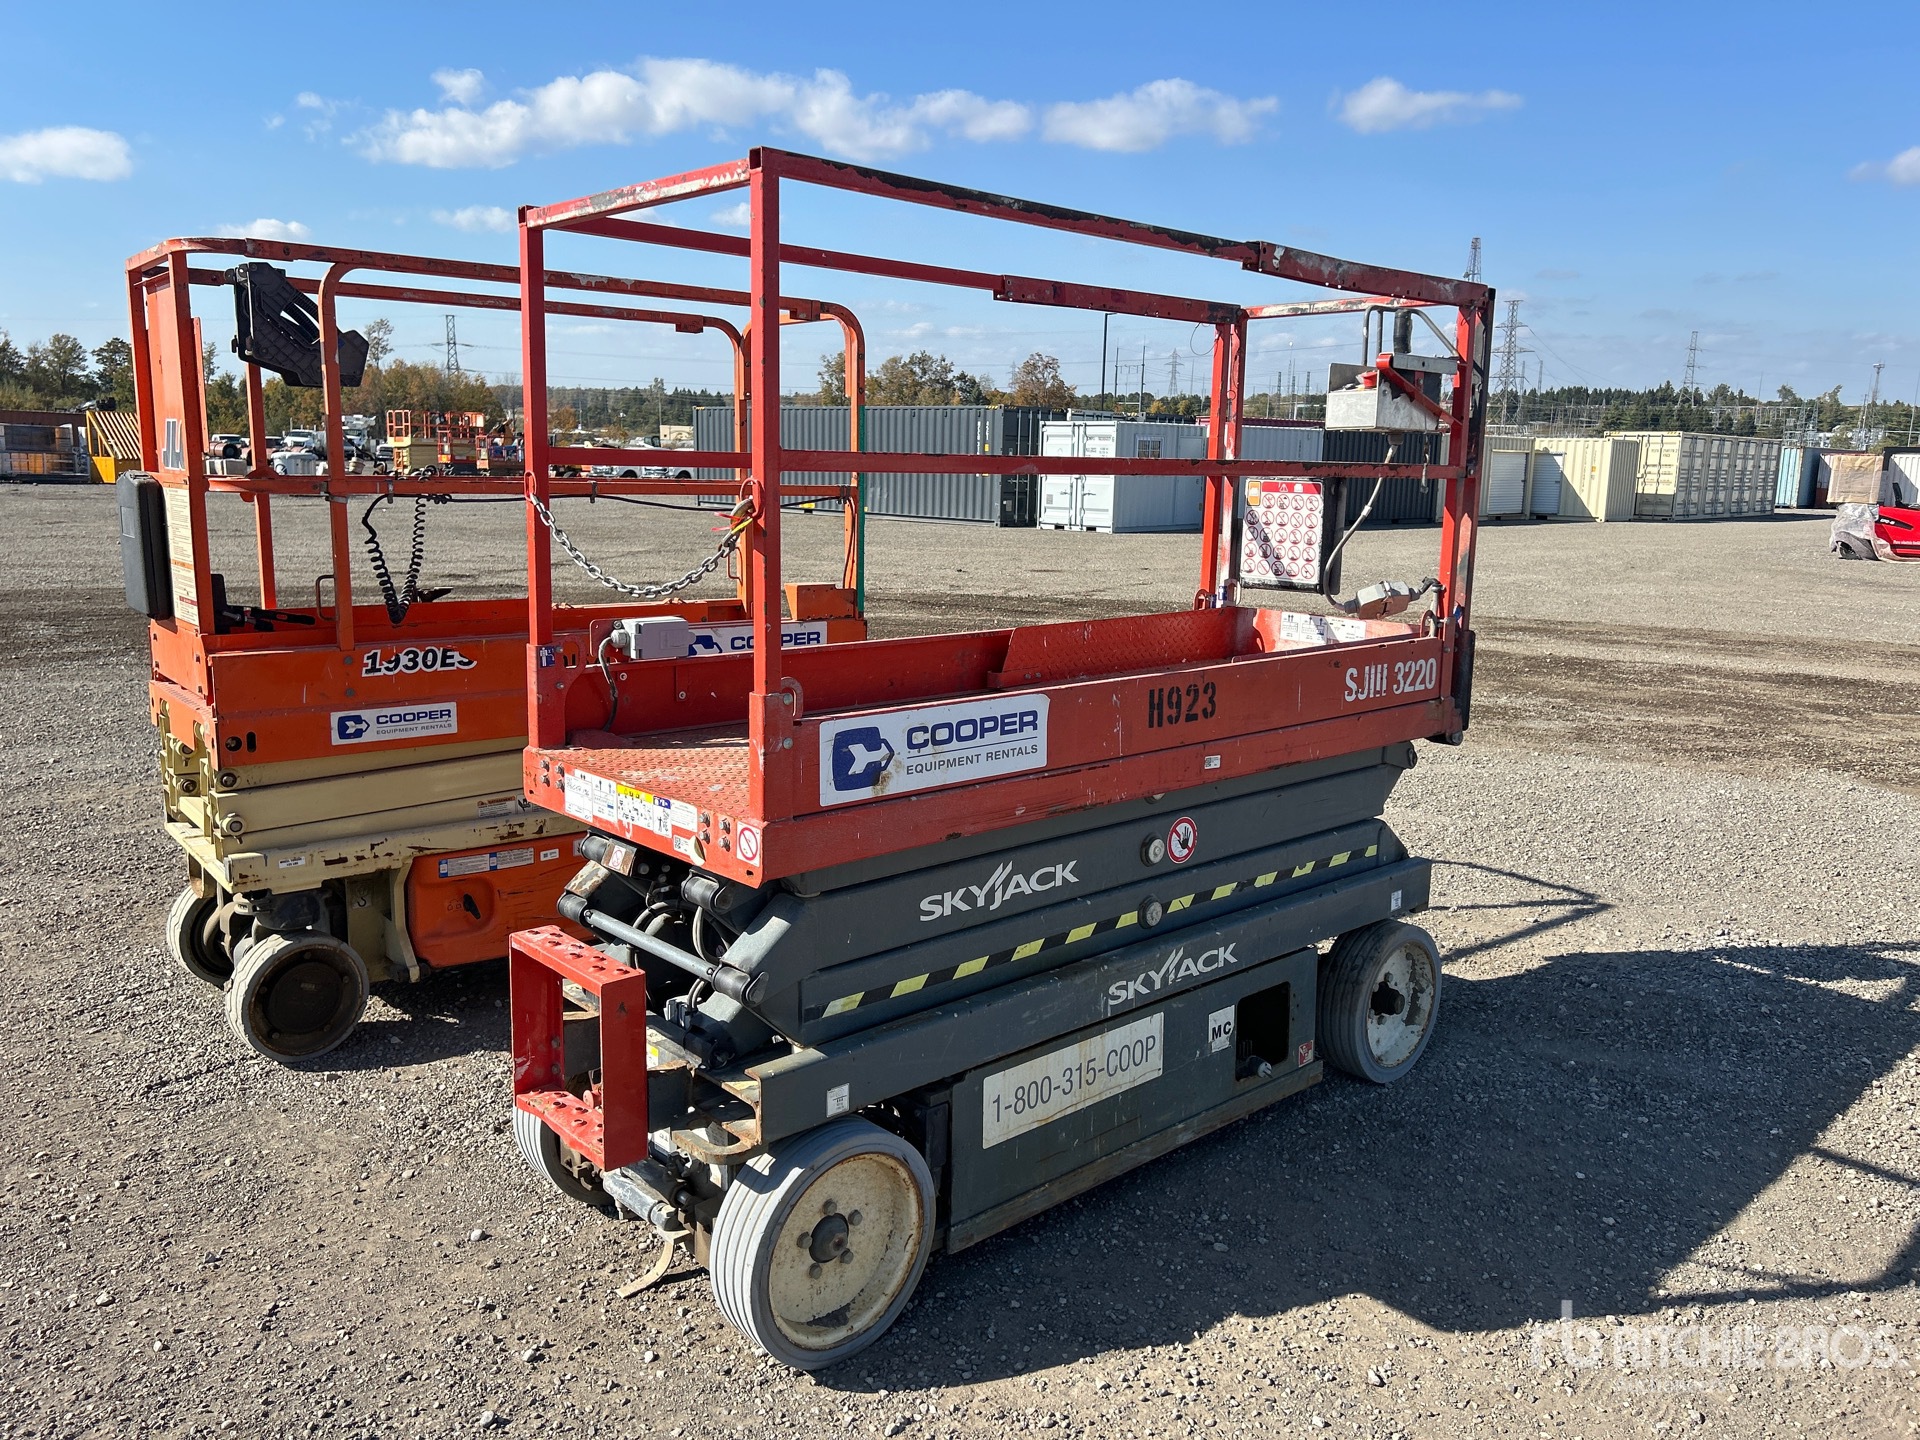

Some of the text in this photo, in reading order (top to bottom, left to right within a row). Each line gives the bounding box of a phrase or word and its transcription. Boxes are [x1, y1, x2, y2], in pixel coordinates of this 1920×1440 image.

[731, 631, 821, 650] CPER
[1393, 657, 1437, 695] 3220
[377, 708, 452, 725] COOPER
[1148, 682, 1217, 728] H923
[376, 723, 452, 735] EQUIPMENT RENTALS
[906, 709, 1039, 750] COOPER
[906, 744, 1038, 775] EQUIPMENT RENTALS
[919, 860, 1080, 922] SKYJACK
[1211, 1020, 1232, 1040] MC
[992, 1034, 1157, 1123] 1-800-315-COOP
